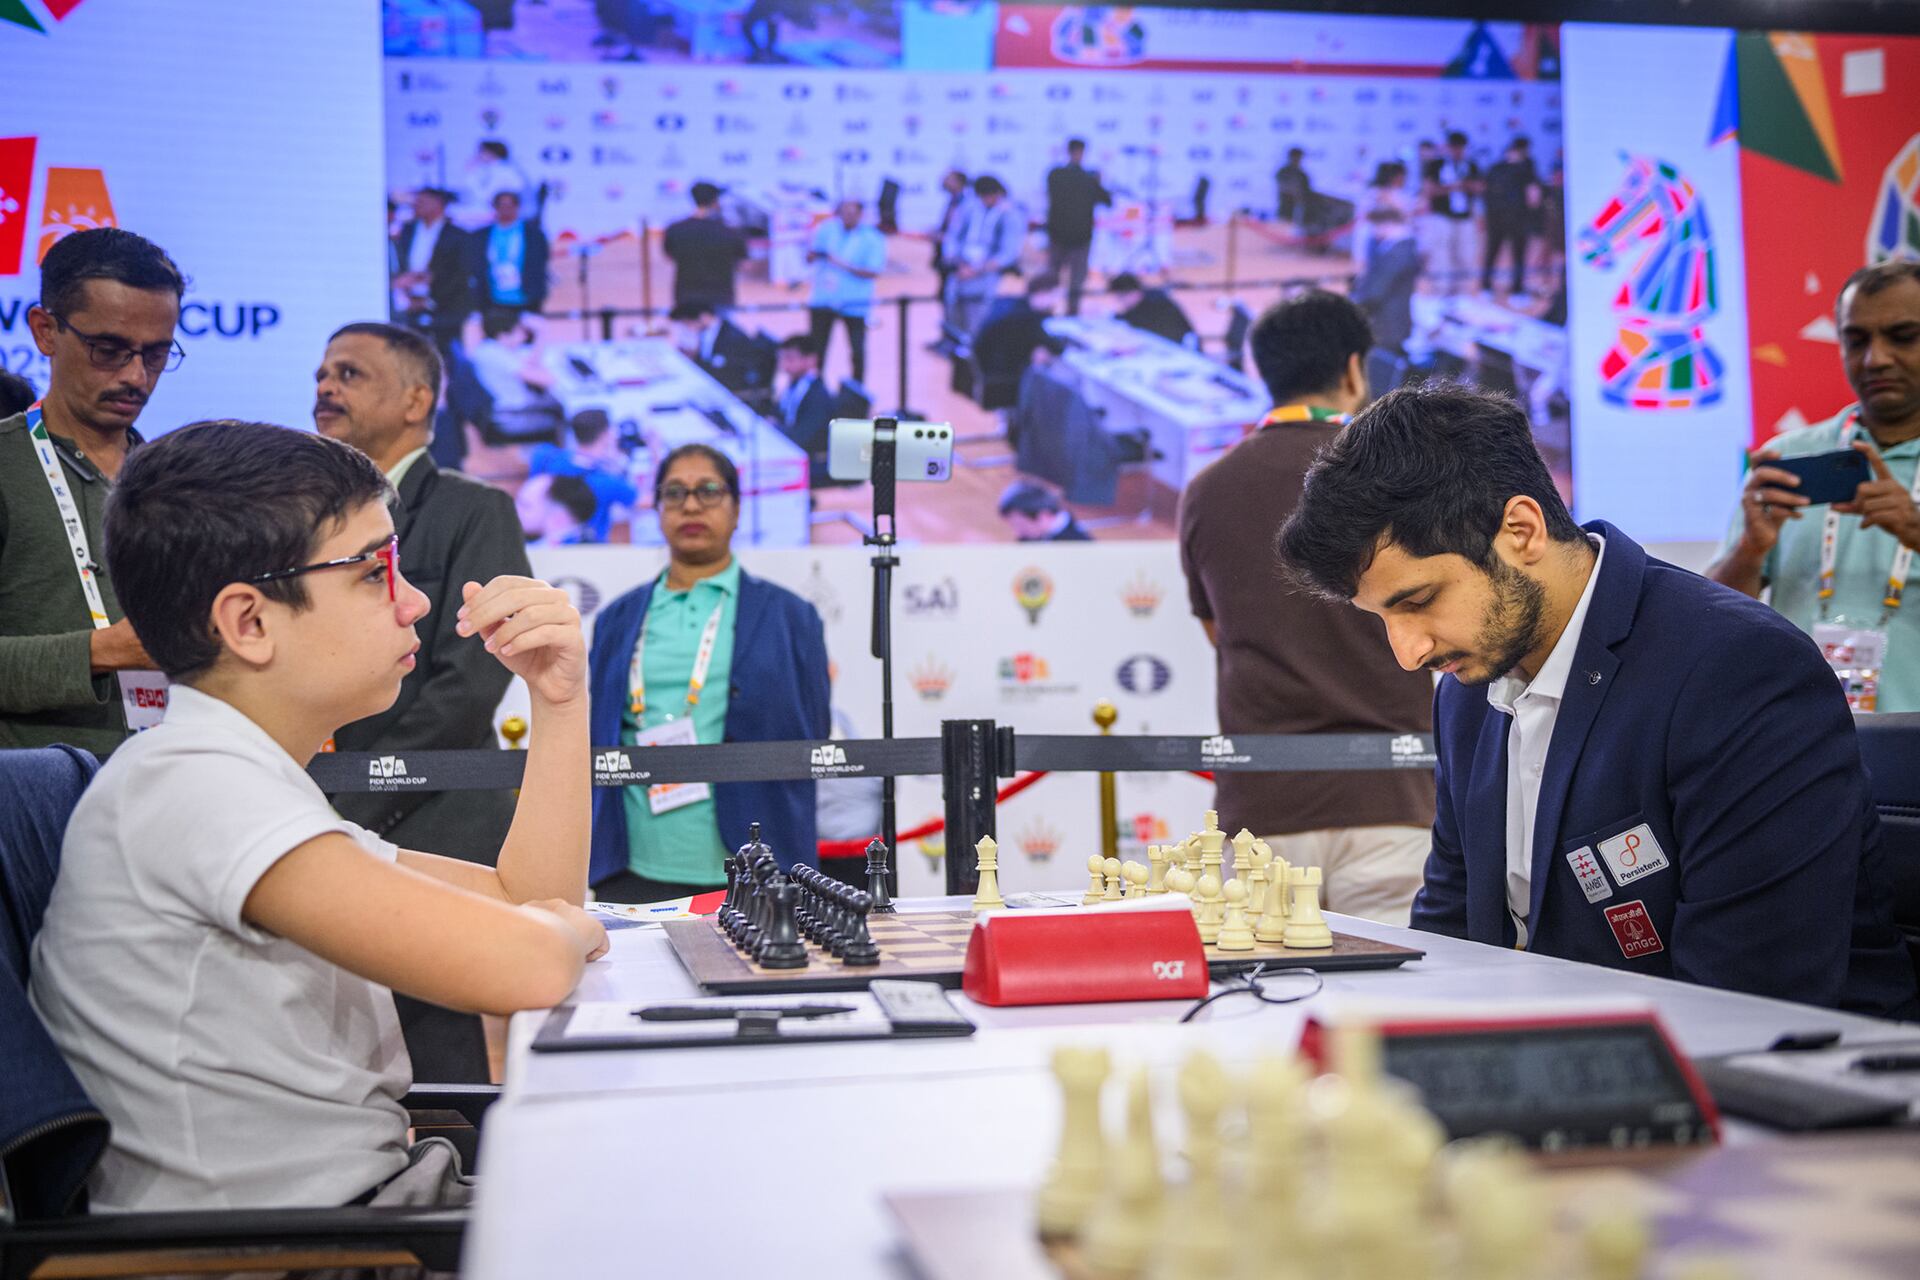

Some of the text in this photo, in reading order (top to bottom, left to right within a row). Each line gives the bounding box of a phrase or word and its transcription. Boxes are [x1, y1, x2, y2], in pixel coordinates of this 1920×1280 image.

[179, 304, 279, 337] CUP
[412, 776, 428, 784] CUP
[636, 771, 651, 779] CUP
[1620, 860, 1662, 880] Persistent
[1152, 960, 1184, 980] DGT
